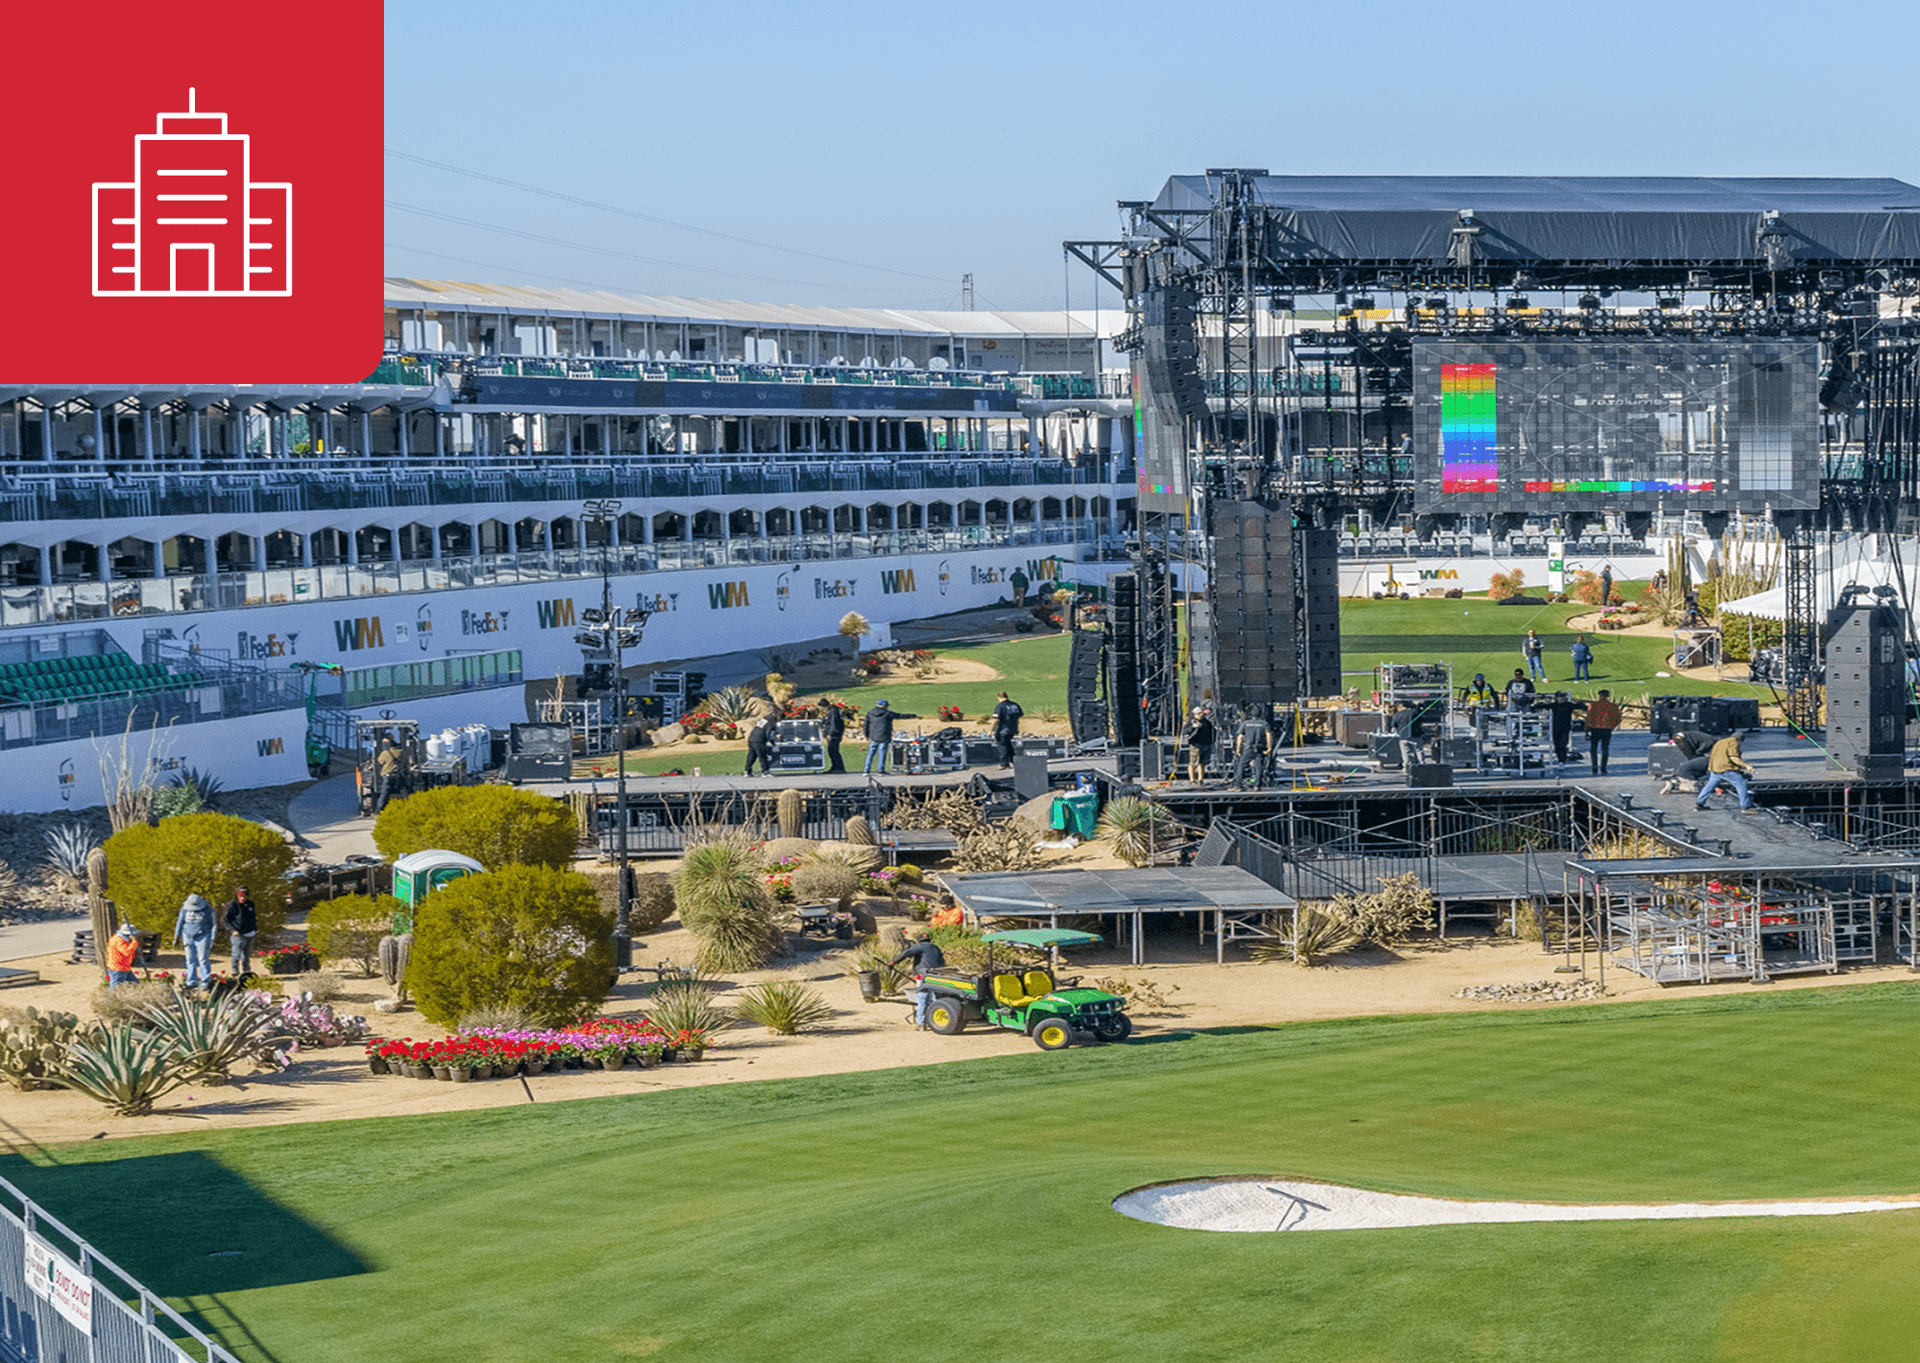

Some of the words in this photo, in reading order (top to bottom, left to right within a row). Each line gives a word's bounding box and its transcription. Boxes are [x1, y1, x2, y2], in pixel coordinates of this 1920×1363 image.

[881, 569, 916, 594] WM
[978, 567, 998, 584] FedEx
[1026, 559, 1057, 581] WM
[1418, 569, 1459, 579] WM
[707, 581, 750, 609] WM
[823, 580, 847, 598] FedEx
[471, 611, 499, 635] FedEx
[537, 598, 576, 629] WM
[250, 633, 286, 659] FedEx
[334, 616, 384, 652] WM
[256, 737, 284, 757] WM
